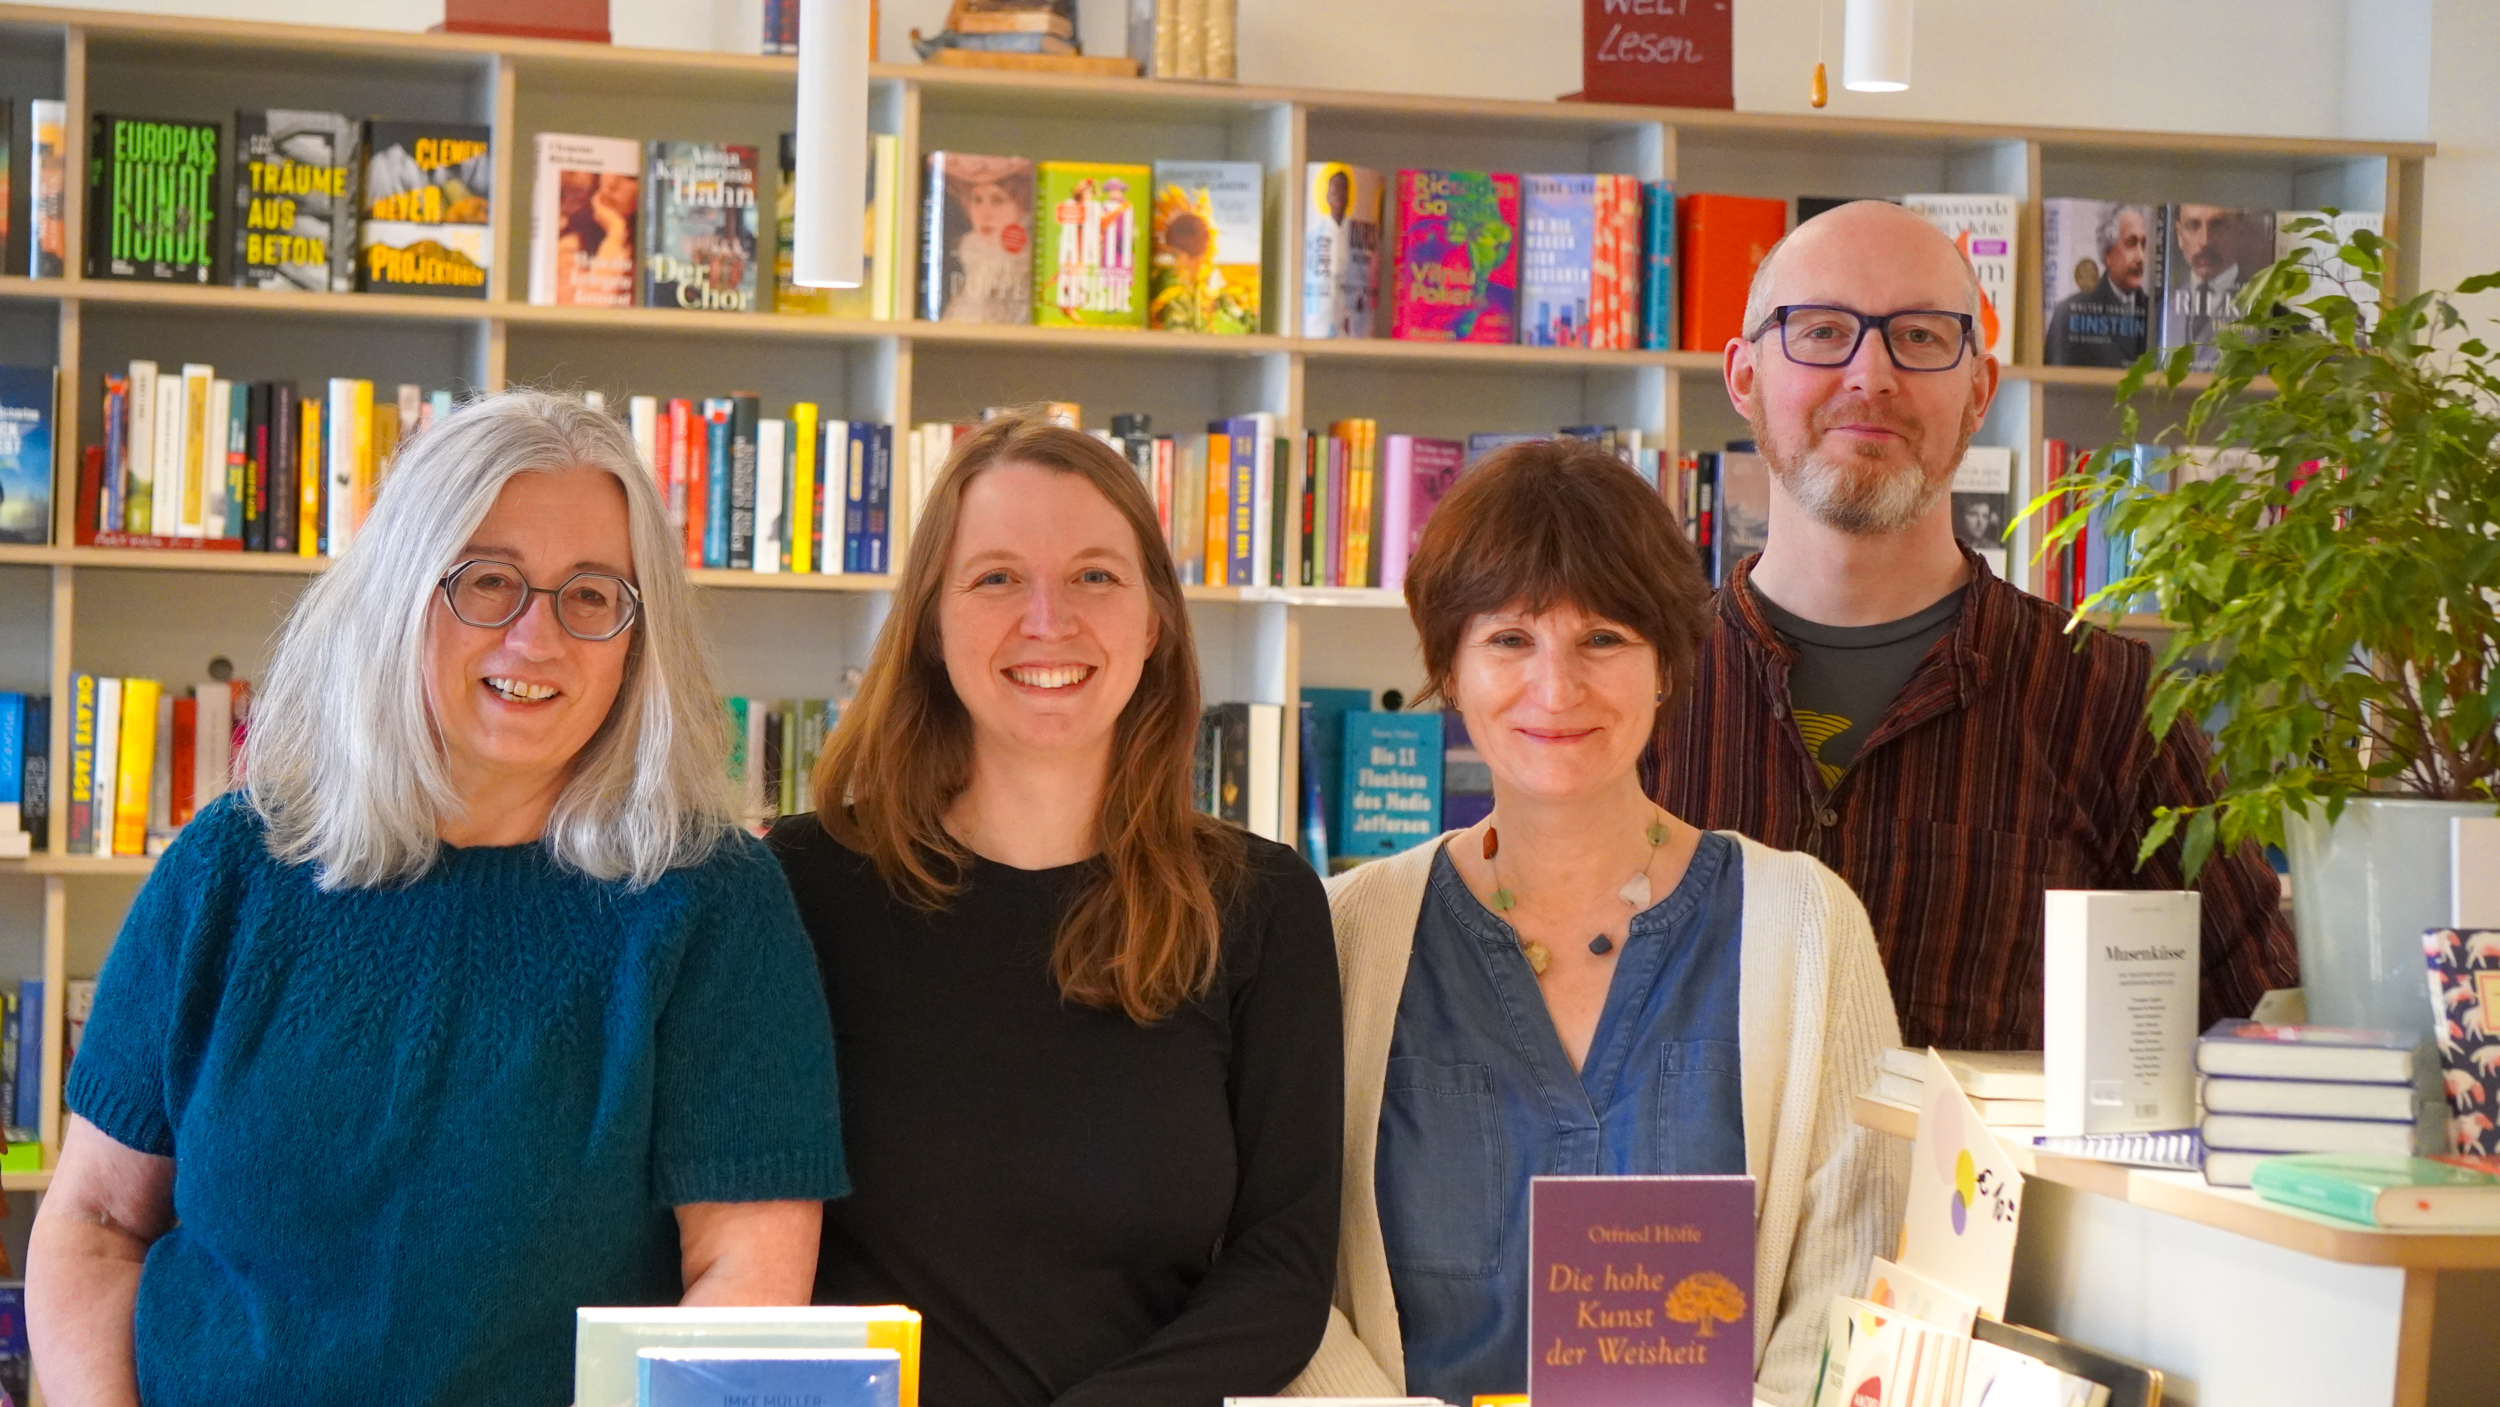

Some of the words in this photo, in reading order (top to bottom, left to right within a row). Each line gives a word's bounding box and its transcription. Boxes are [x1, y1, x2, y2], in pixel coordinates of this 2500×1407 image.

[1596, 23, 1703, 64] Lesen
[114, 120, 216, 174] EUROPAS
[249, 159, 347, 197] TRÄUME
[247, 198, 296, 231] AUS
[247, 233, 325, 266] BETON
[651, 253, 711, 286] Der
[676, 279, 754, 310] Chor
[2175, 289, 2252, 318] RILK
[2068, 313, 2145, 338] EINSTEIN
[1370, 746, 1396, 766] Die
[1353, 791, 1382, 810] des
[1353, 814, 1430, 834] Jefferson
[2105, 945, 2186, 962] Musenküsse
[1588, 1225, 1649, 1244] Otfried
[1654, 1225, 1702, 1244] Höffe
[1549, 1263, 1594, 1292] Die
[1603, 1263, 1664, 1292] hohe
[1577, 1300, 1655, 1329] Kunst
[1545, 1338, 1587, 1366] der
[1598, 1336, 1707, 1365] Weisheit
